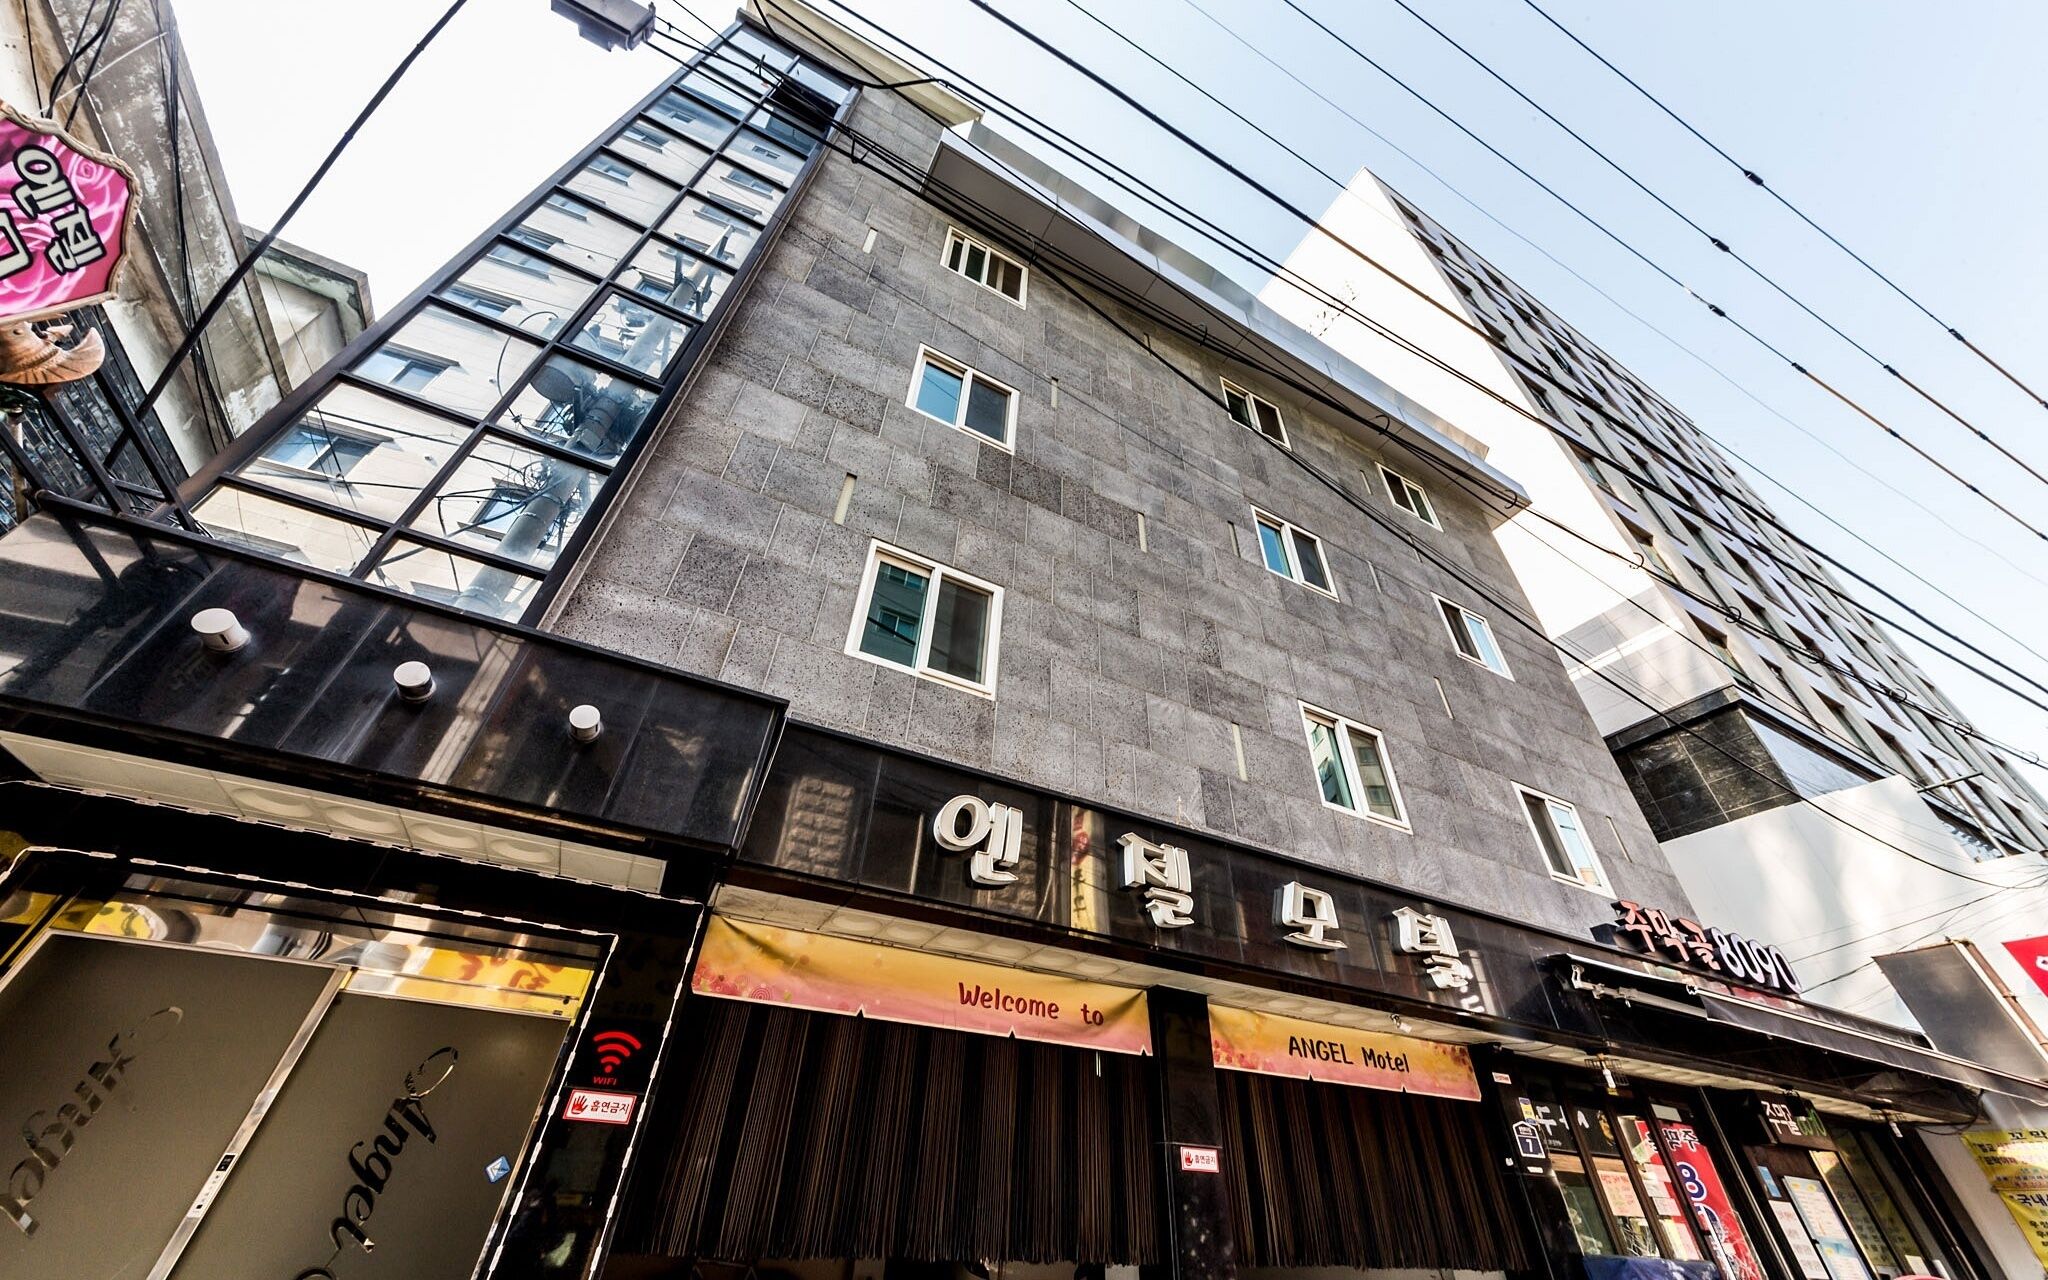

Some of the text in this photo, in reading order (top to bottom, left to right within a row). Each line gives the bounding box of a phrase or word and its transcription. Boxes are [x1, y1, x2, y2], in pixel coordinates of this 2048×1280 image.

[11, 145, 107, 276] 엔젤
[958, 982, 1105, 1028] Welcome to
[1288, 1035, 1410, 1073] ANGEL Motel
[590, 1100, 630, 1115] 흡연금지
[2016, 1193, 2048, 1207] 국내
